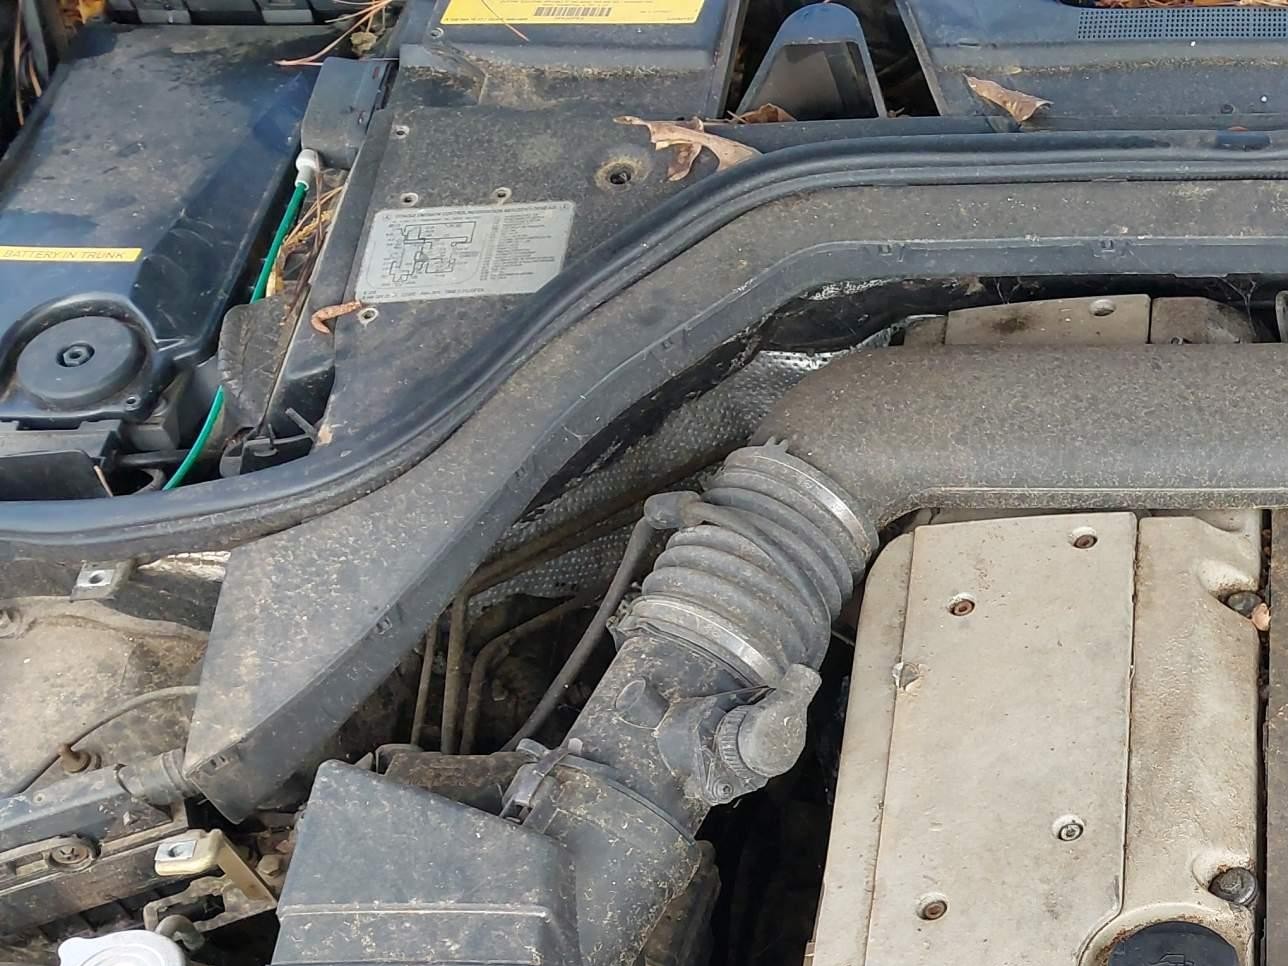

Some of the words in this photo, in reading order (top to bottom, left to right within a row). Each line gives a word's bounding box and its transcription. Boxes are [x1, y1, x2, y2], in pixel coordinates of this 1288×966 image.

[3, 249, 58, 259] BATTERY
[63, 250, 75, 259] IN
[80, 251, 125, 260] TRUNK
